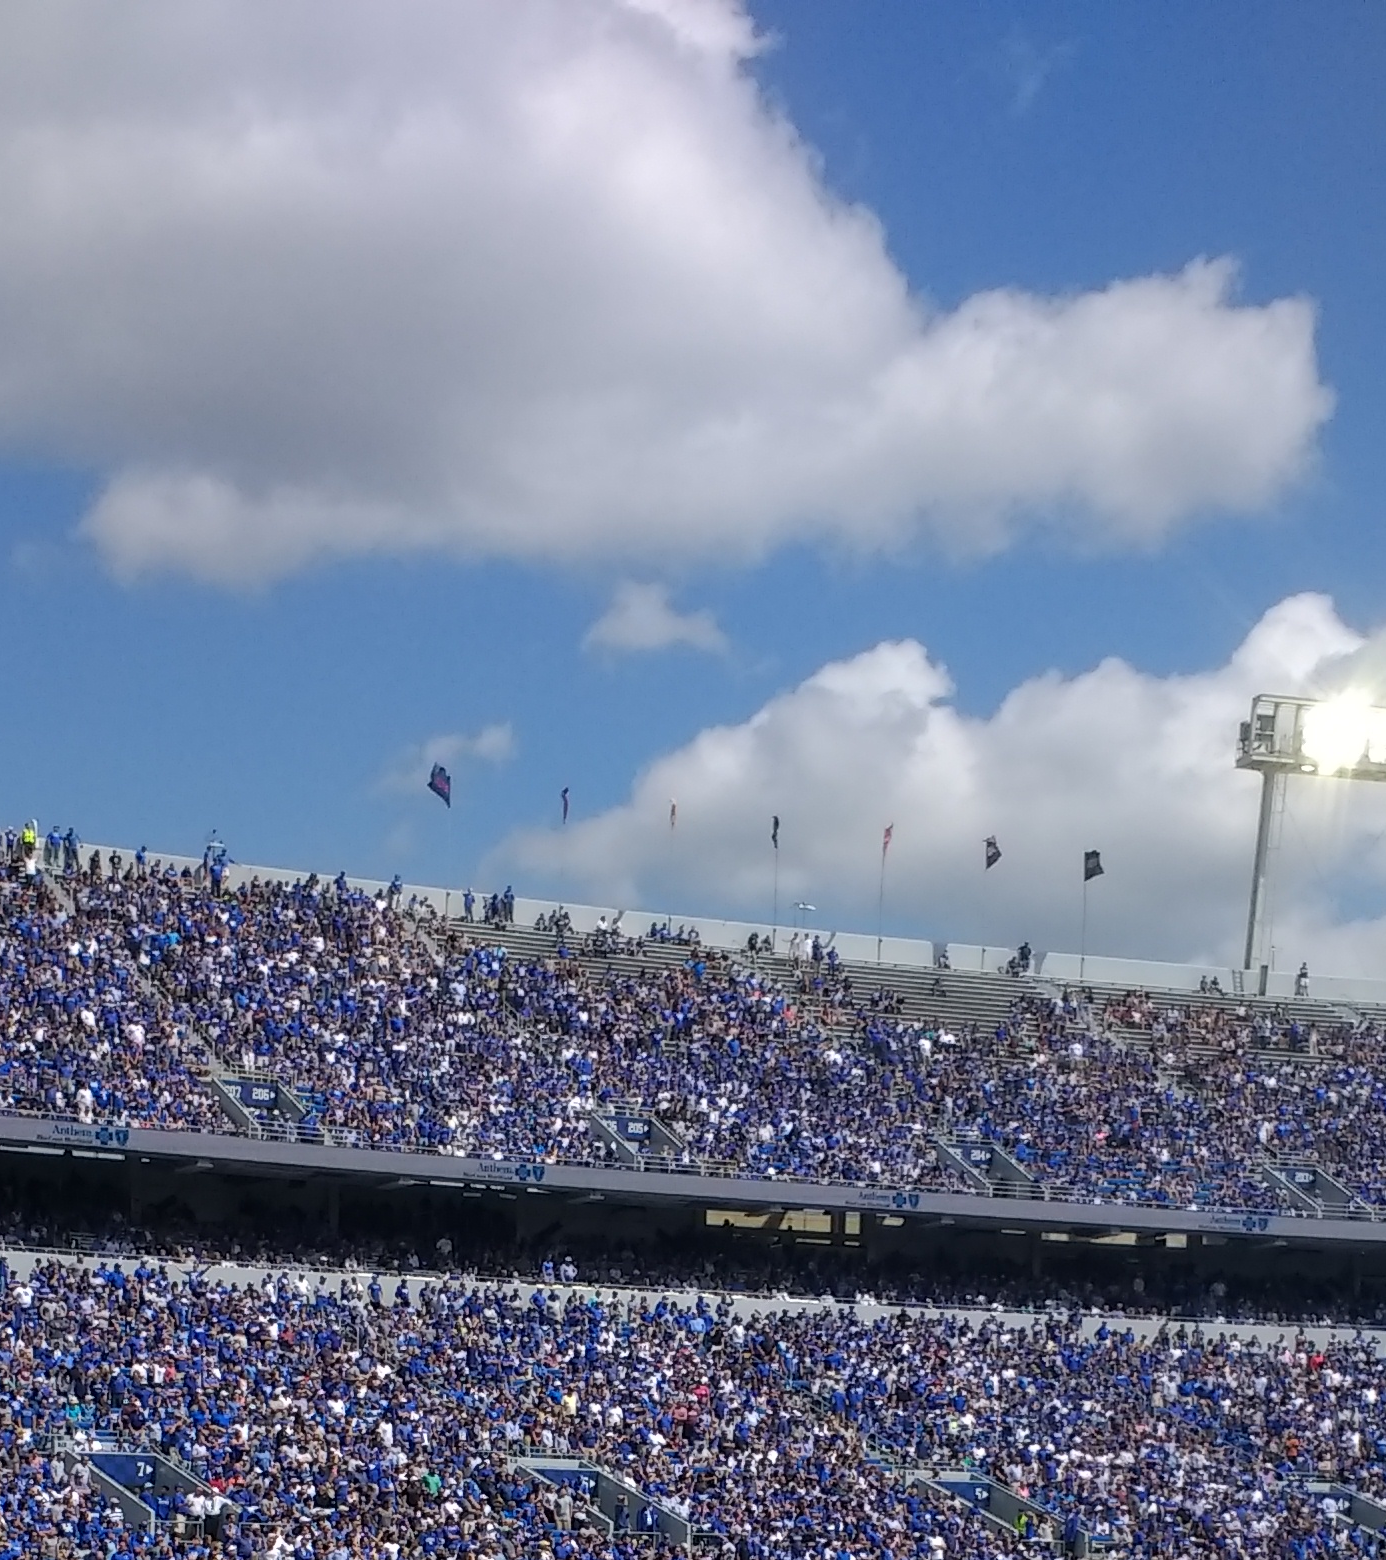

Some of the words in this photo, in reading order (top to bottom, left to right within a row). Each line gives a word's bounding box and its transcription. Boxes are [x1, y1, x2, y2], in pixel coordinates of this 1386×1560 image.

[252, 1088, 270, 1101] 206
[53, 1125, 94, 1137] Anthem
[137, 1461, 145, 1477] 7
[974, 1487, 983, 1500] 5
